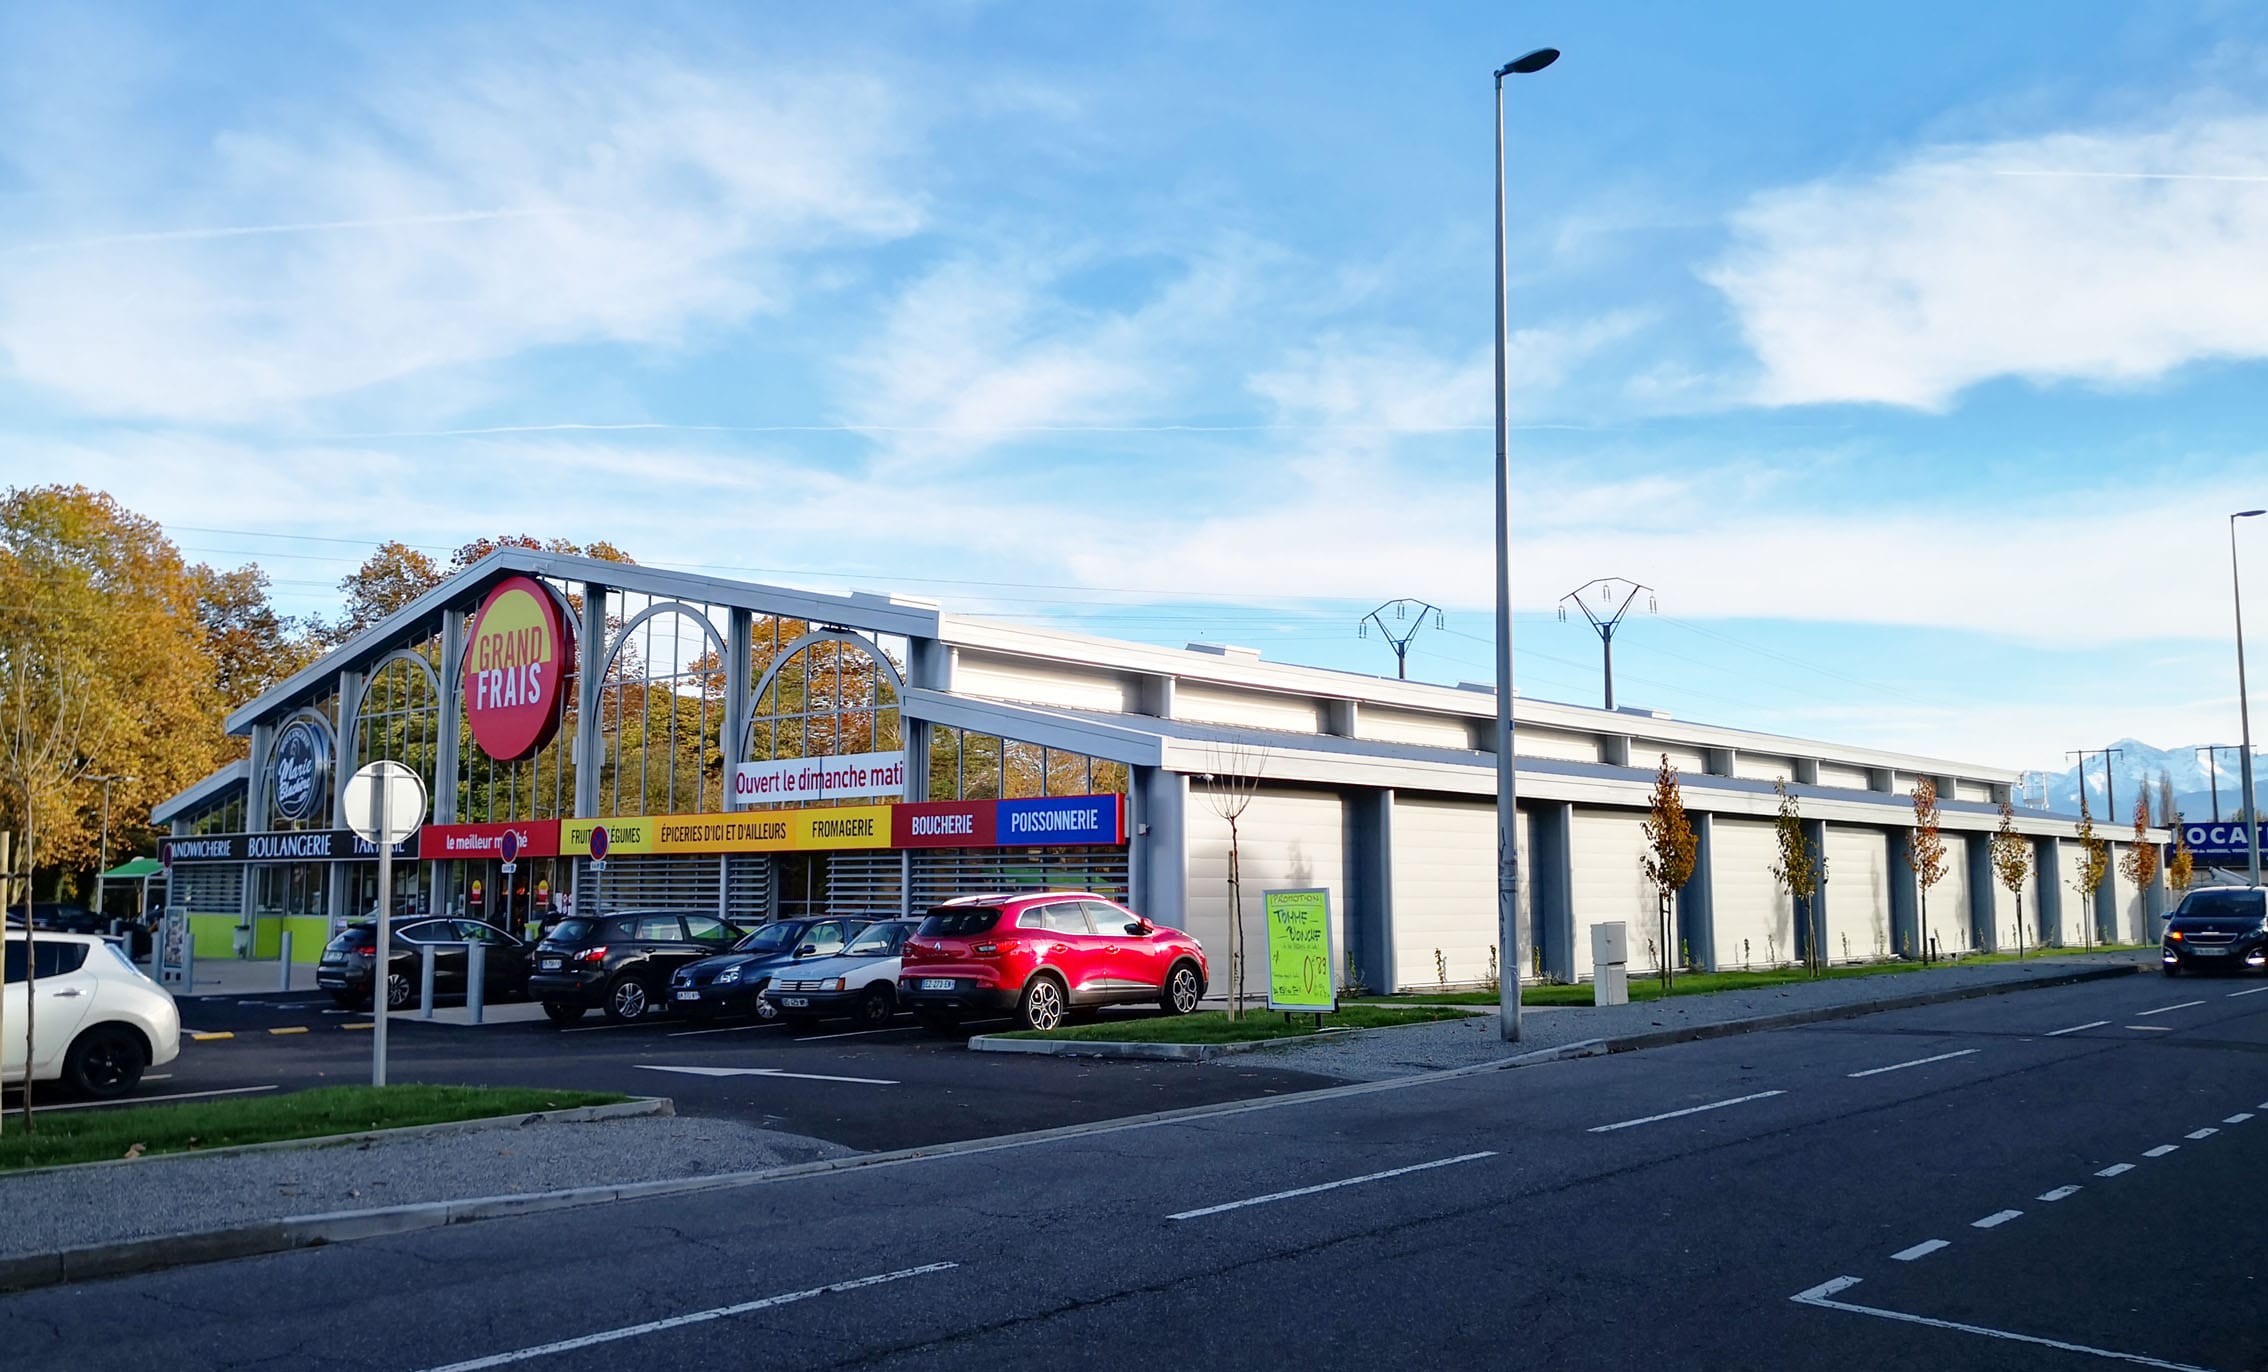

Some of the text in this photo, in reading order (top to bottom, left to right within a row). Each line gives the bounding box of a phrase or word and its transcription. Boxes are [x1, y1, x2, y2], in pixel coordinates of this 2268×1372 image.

[479, 626, 543, 671] GRAND
[477, 662, 541, 710] FRAIS
[736, 761, 903, 794] Ouvert le dimanche mati
[812, 818, 874, 838] FROMAGERIE
[912, 814, 974, 836] BOUCHERIE
[1011, 809, 1098, 833] POISSONNERIE
[446, 829, 528, 850] le meilleur mhé
[571, 829, 592, 844] FRUIT
[661, 822, 786, 843] ÉPICERIES D'ICI ET D'AILLEURS
[173, 840, 232, 858] ANDWICHERIE
[248, 835, 332, 858] BOULANGERIE
